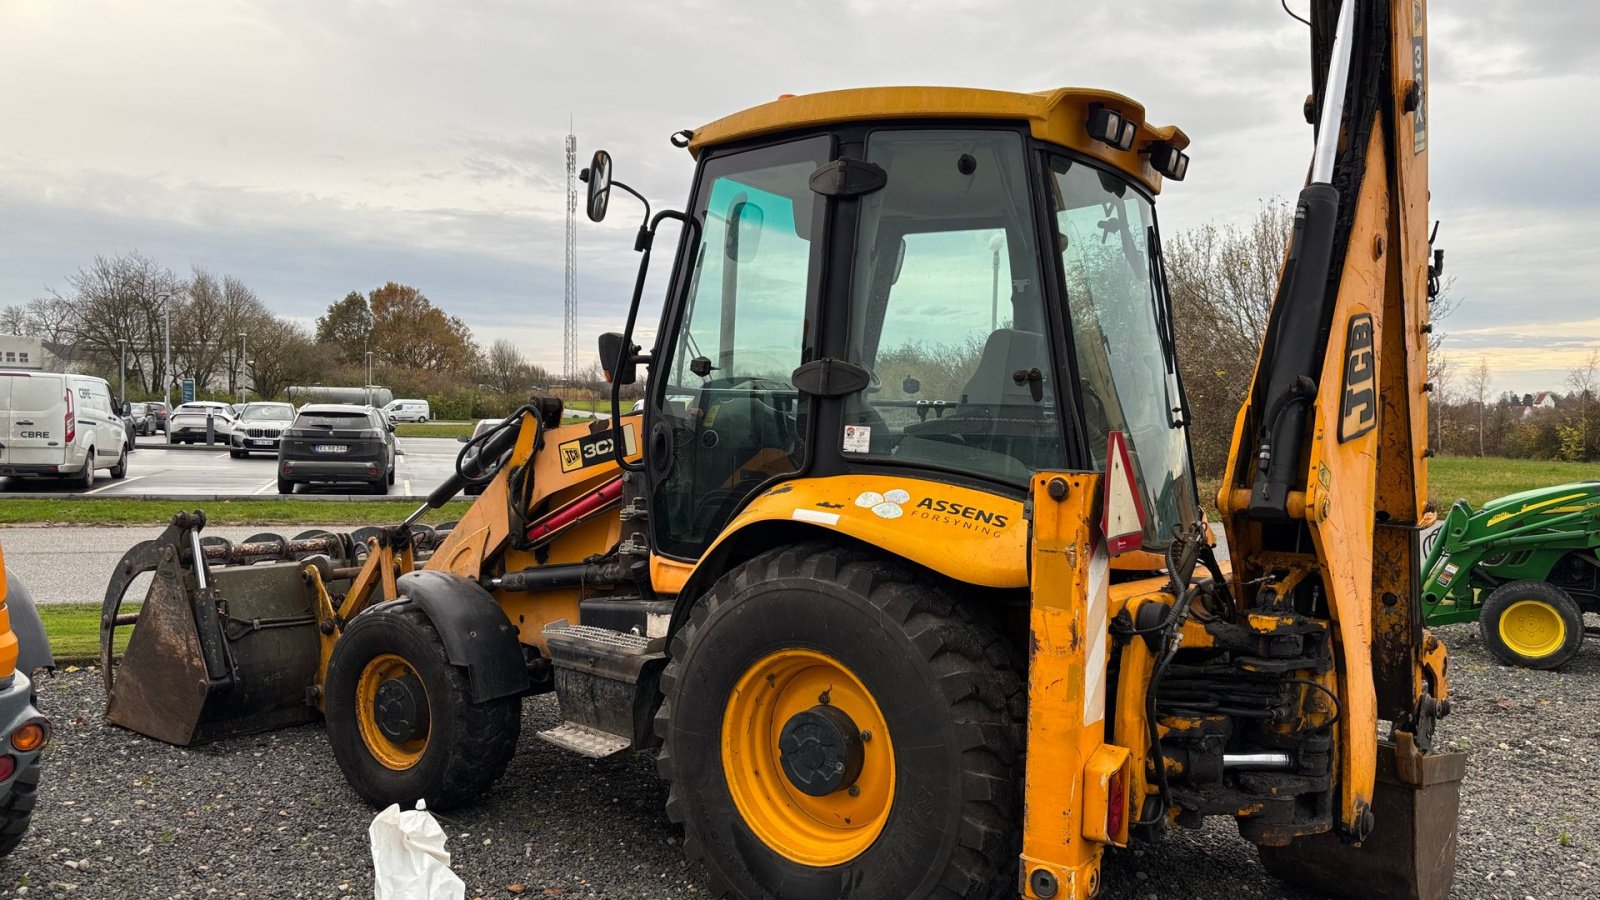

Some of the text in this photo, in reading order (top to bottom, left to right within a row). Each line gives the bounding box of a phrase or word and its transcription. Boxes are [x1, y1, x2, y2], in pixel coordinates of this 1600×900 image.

[1345, 322, 1374, 424] JCB
[20, 431, 50, 439] CBRE
[563, 449, 580, 465] JCB
[911, 510, 1001, 538] FORSYNING
[917, 497, 1009, 528] ASSENS
